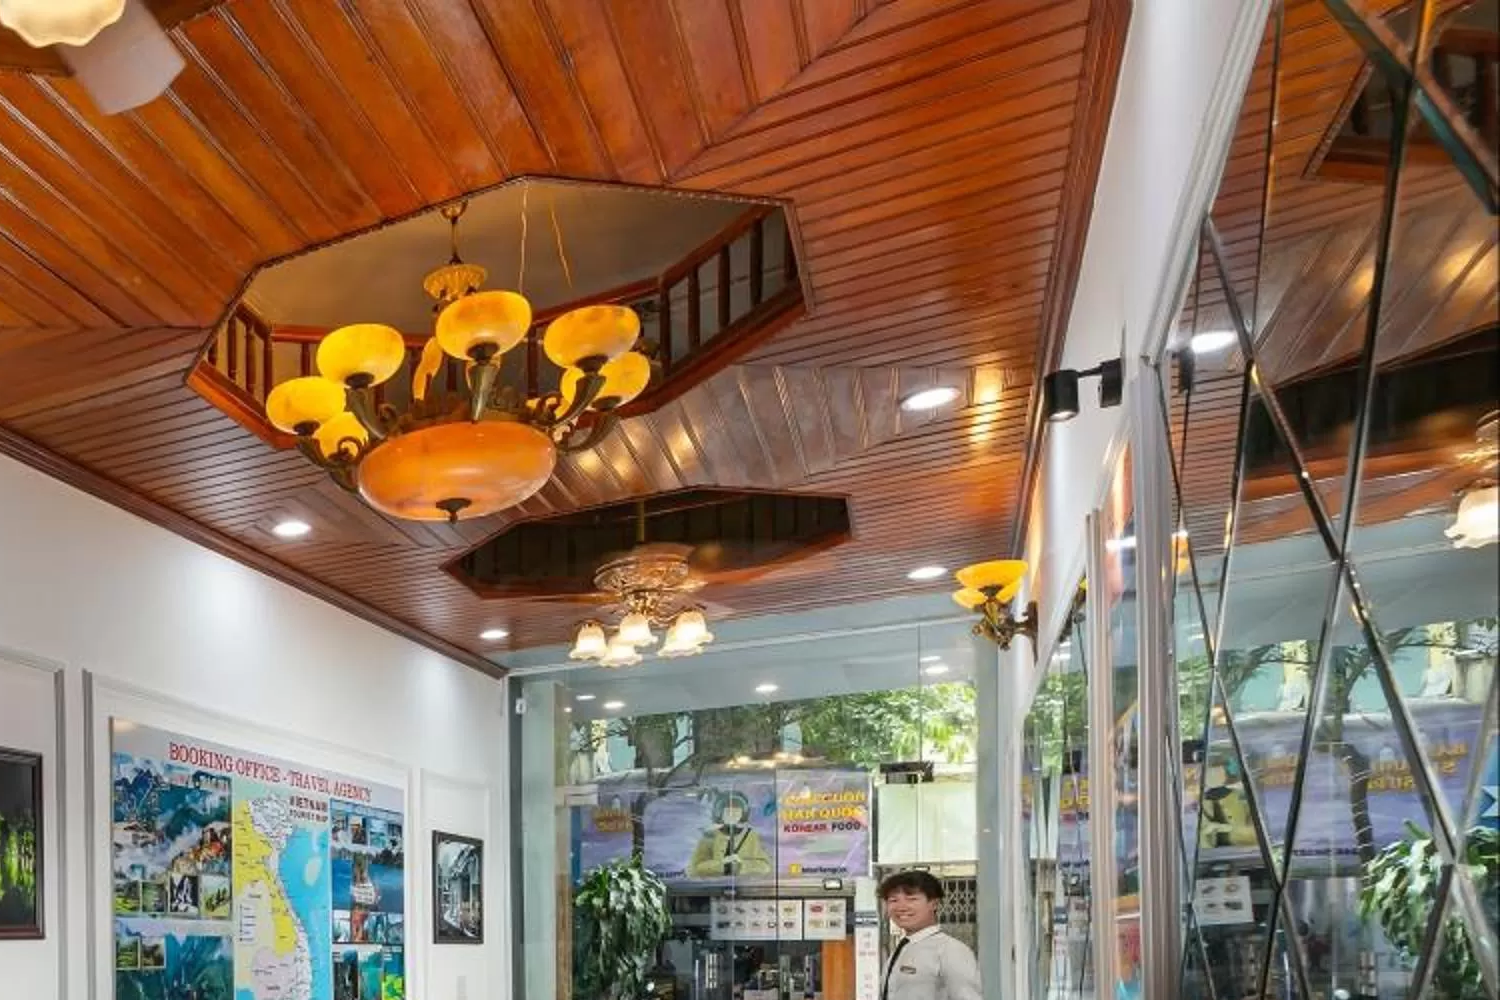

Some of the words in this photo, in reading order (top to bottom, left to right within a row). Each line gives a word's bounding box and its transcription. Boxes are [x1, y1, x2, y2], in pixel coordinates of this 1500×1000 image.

[169, 742, 234, 773] BOOKING
[235, 758, 280, 783] OFFICE
[288, 769, 331, 794] TRAVEL
[333, 780, 372, 802] AGENCY
[289, 796, 328, 812] VIETNAM
[289, 809, 315, 821] TOURIST
[783, 823, 827, 833] KOREAN
[831, 821, 861, 832] FOOD
